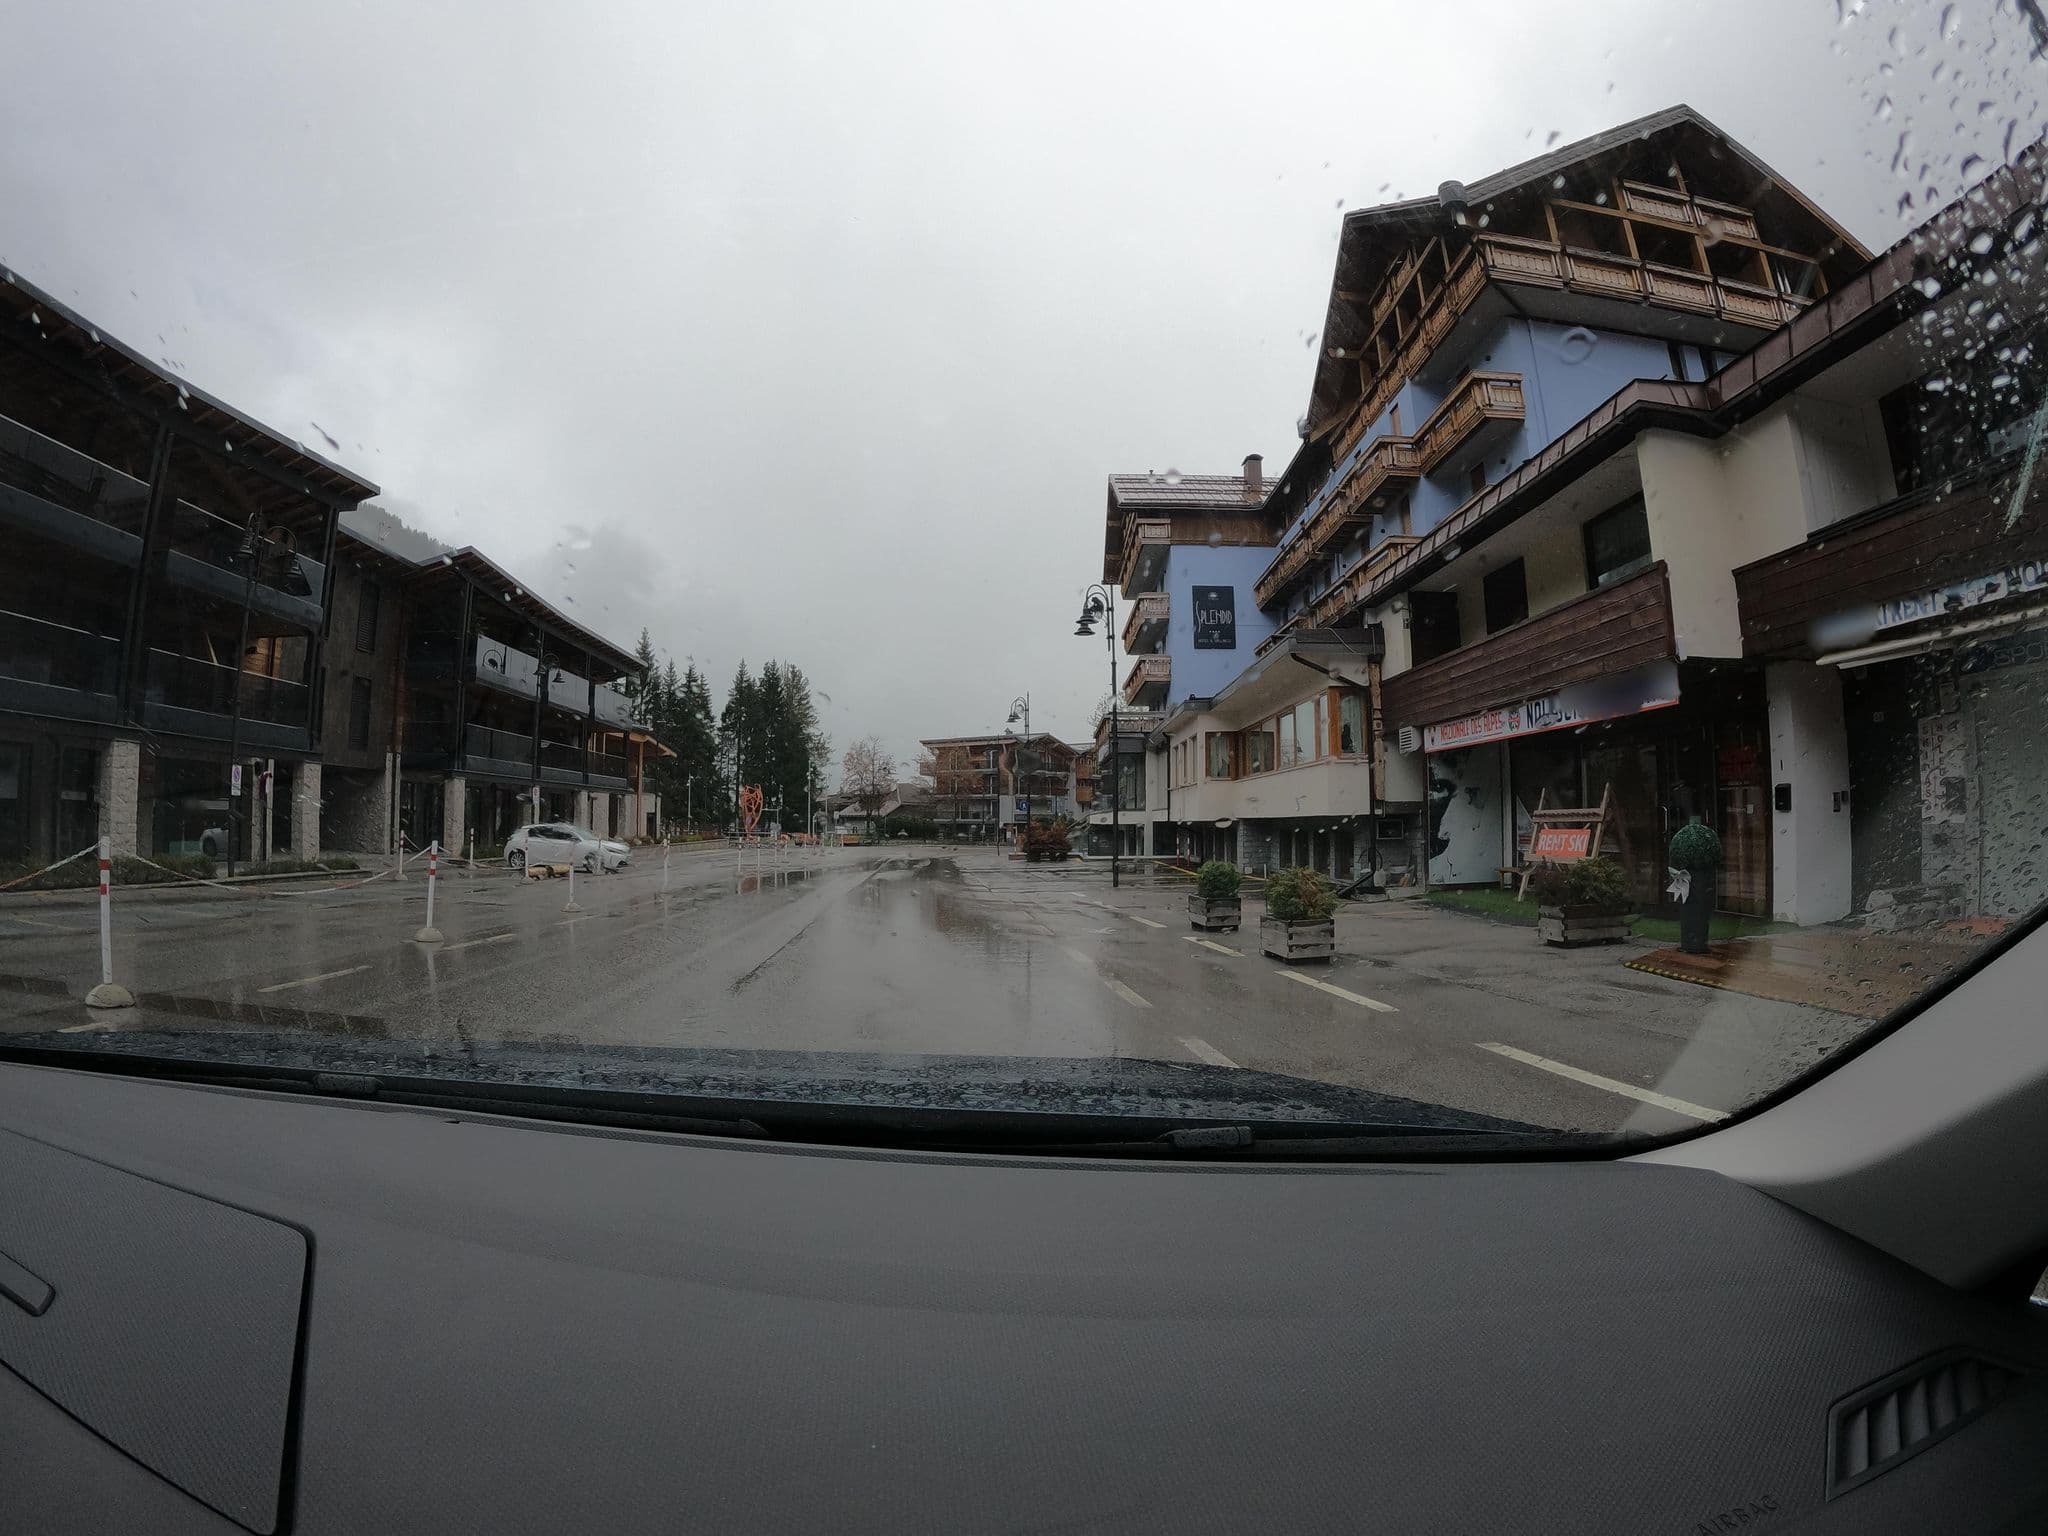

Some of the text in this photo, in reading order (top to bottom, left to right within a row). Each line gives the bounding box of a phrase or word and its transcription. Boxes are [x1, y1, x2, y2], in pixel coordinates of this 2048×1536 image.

[1195, 600, 1233, 633] SPLENDID
[1440, 710, 1502, 742] NAZIONALE DES ALPES
[1538, 833, 1588, 852] RENT SKI
[1697, 1494, 1778, 1536] AIRBAG
